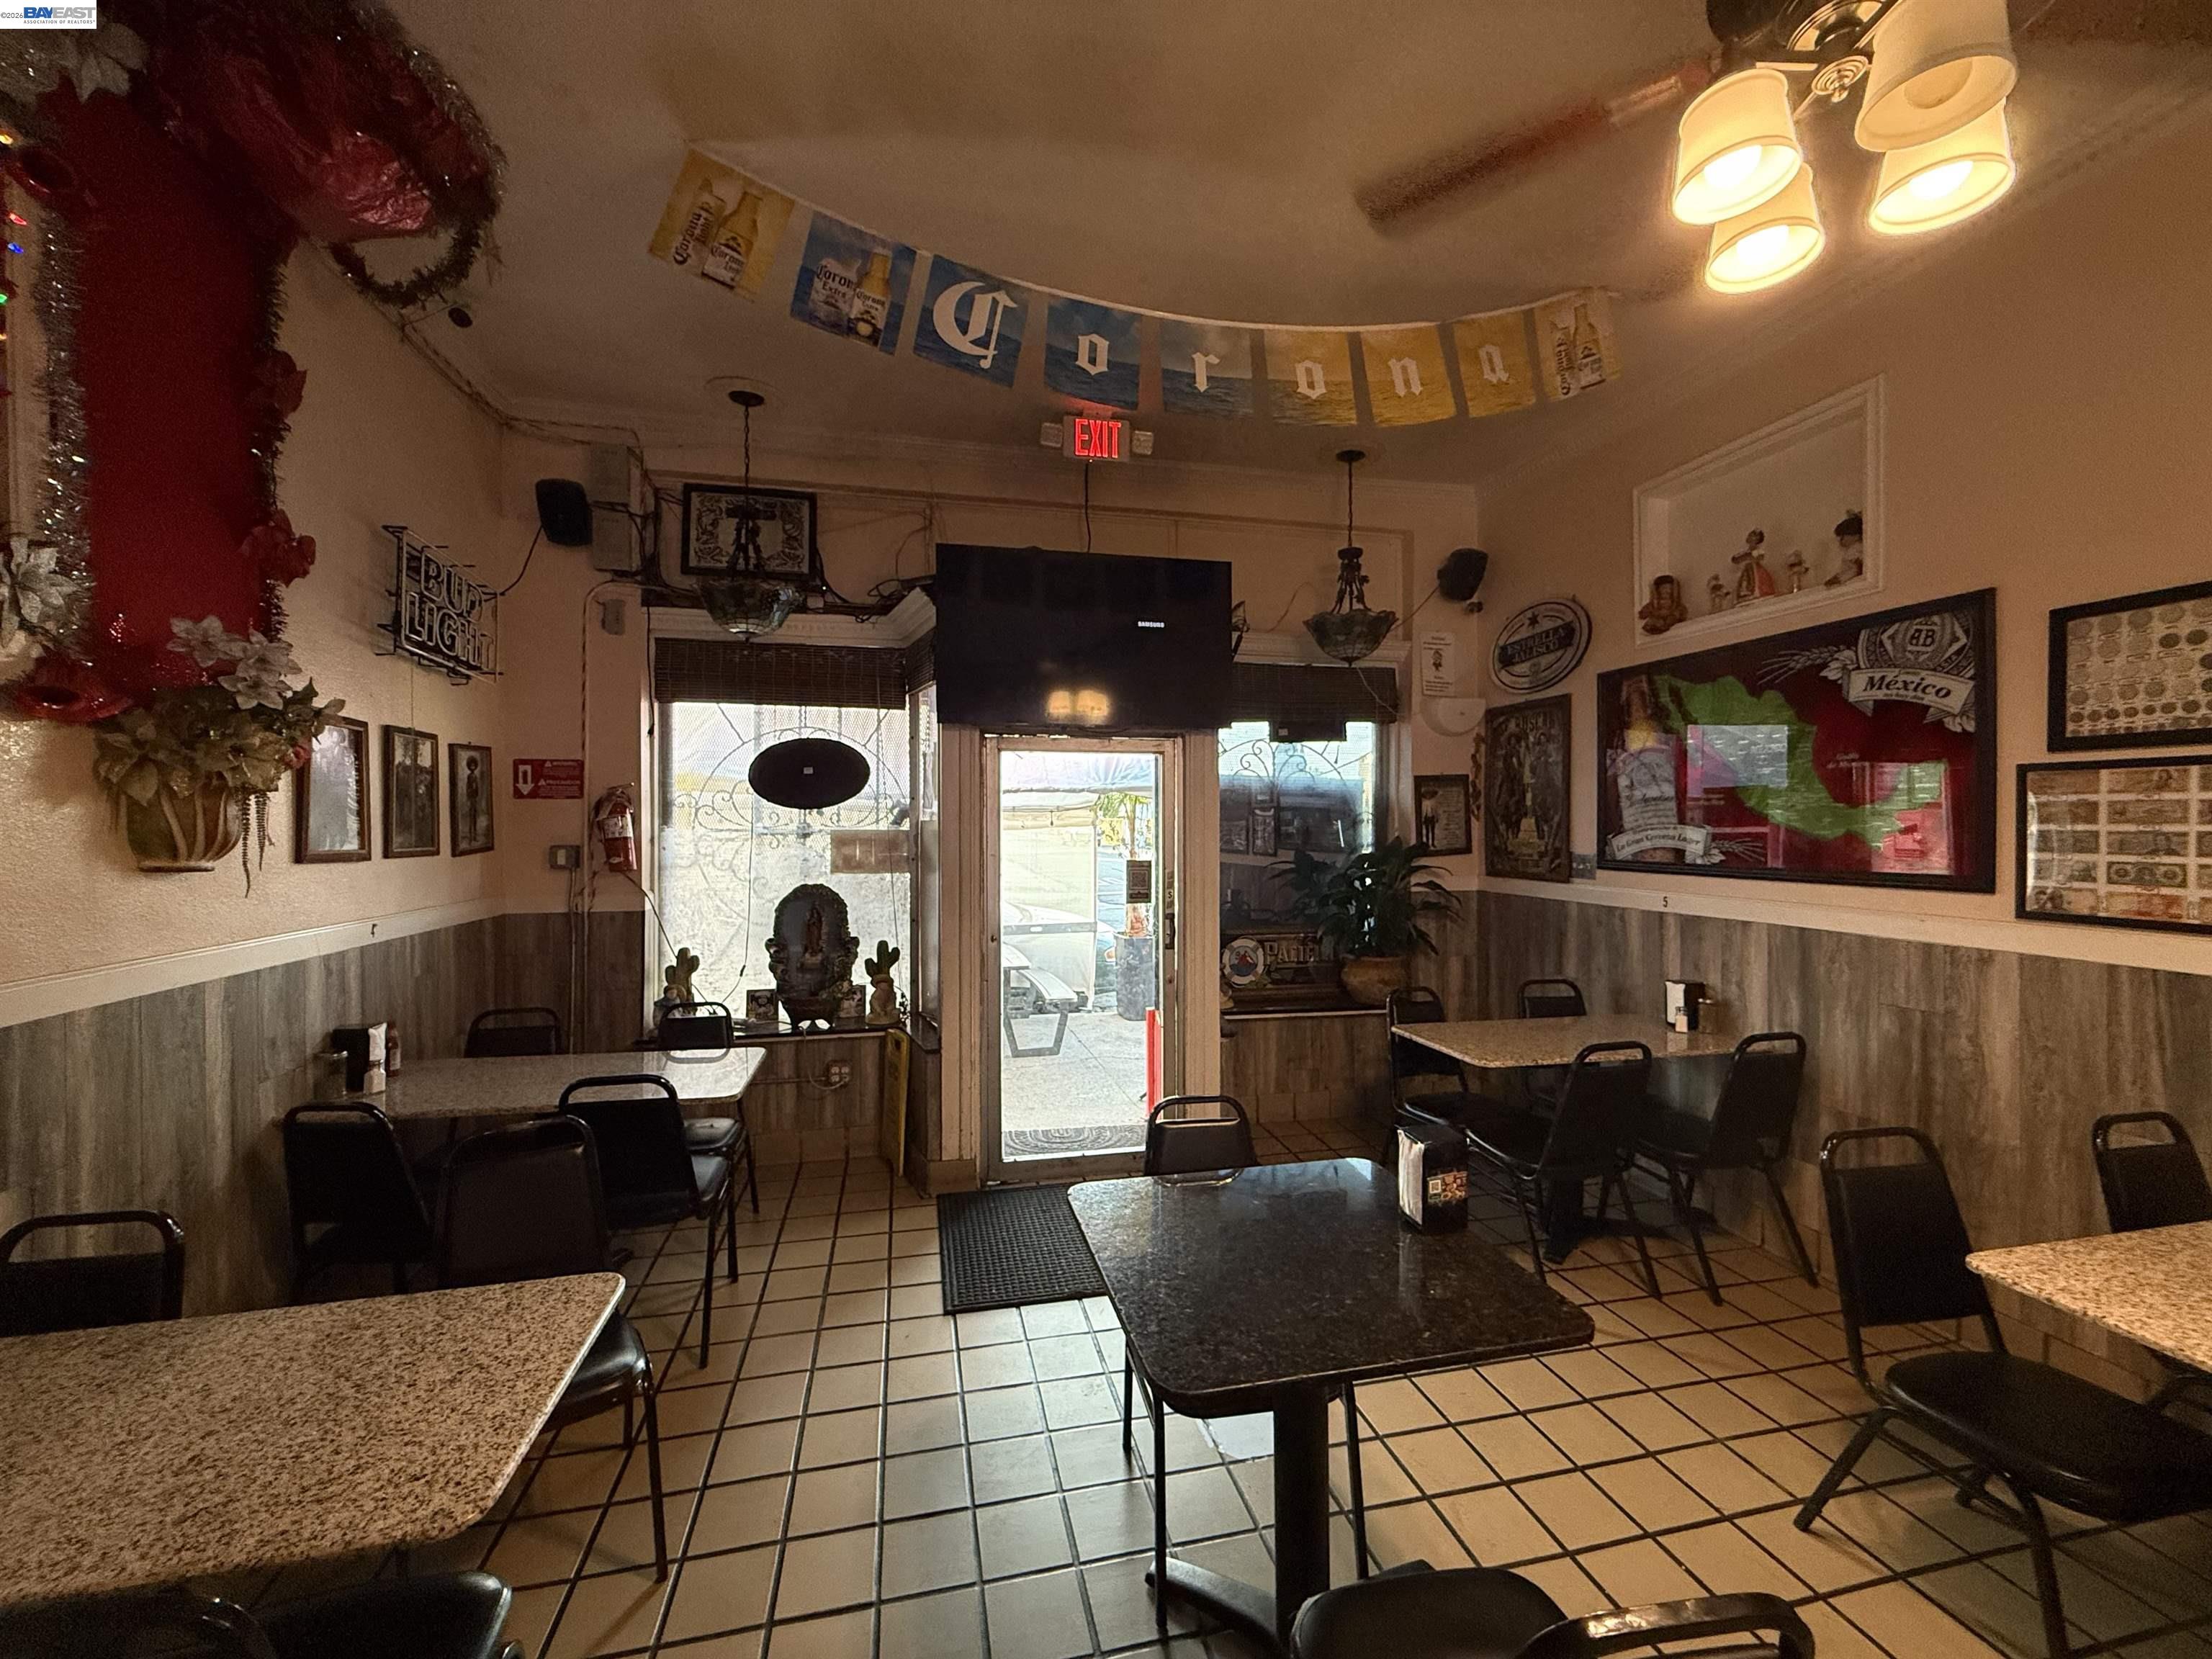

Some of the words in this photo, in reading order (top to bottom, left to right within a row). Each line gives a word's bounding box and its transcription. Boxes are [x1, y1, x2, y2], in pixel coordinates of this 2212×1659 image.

[816, 263, 855, 290] Coron
[822, 279, 847, 299] Extra
[1074, 418, 1121, 458] EXIT
[421, 552, 484, 624] BUD
[405, 591, 495, 671] LIGHT
[1863, 674, 1951, 698] México
